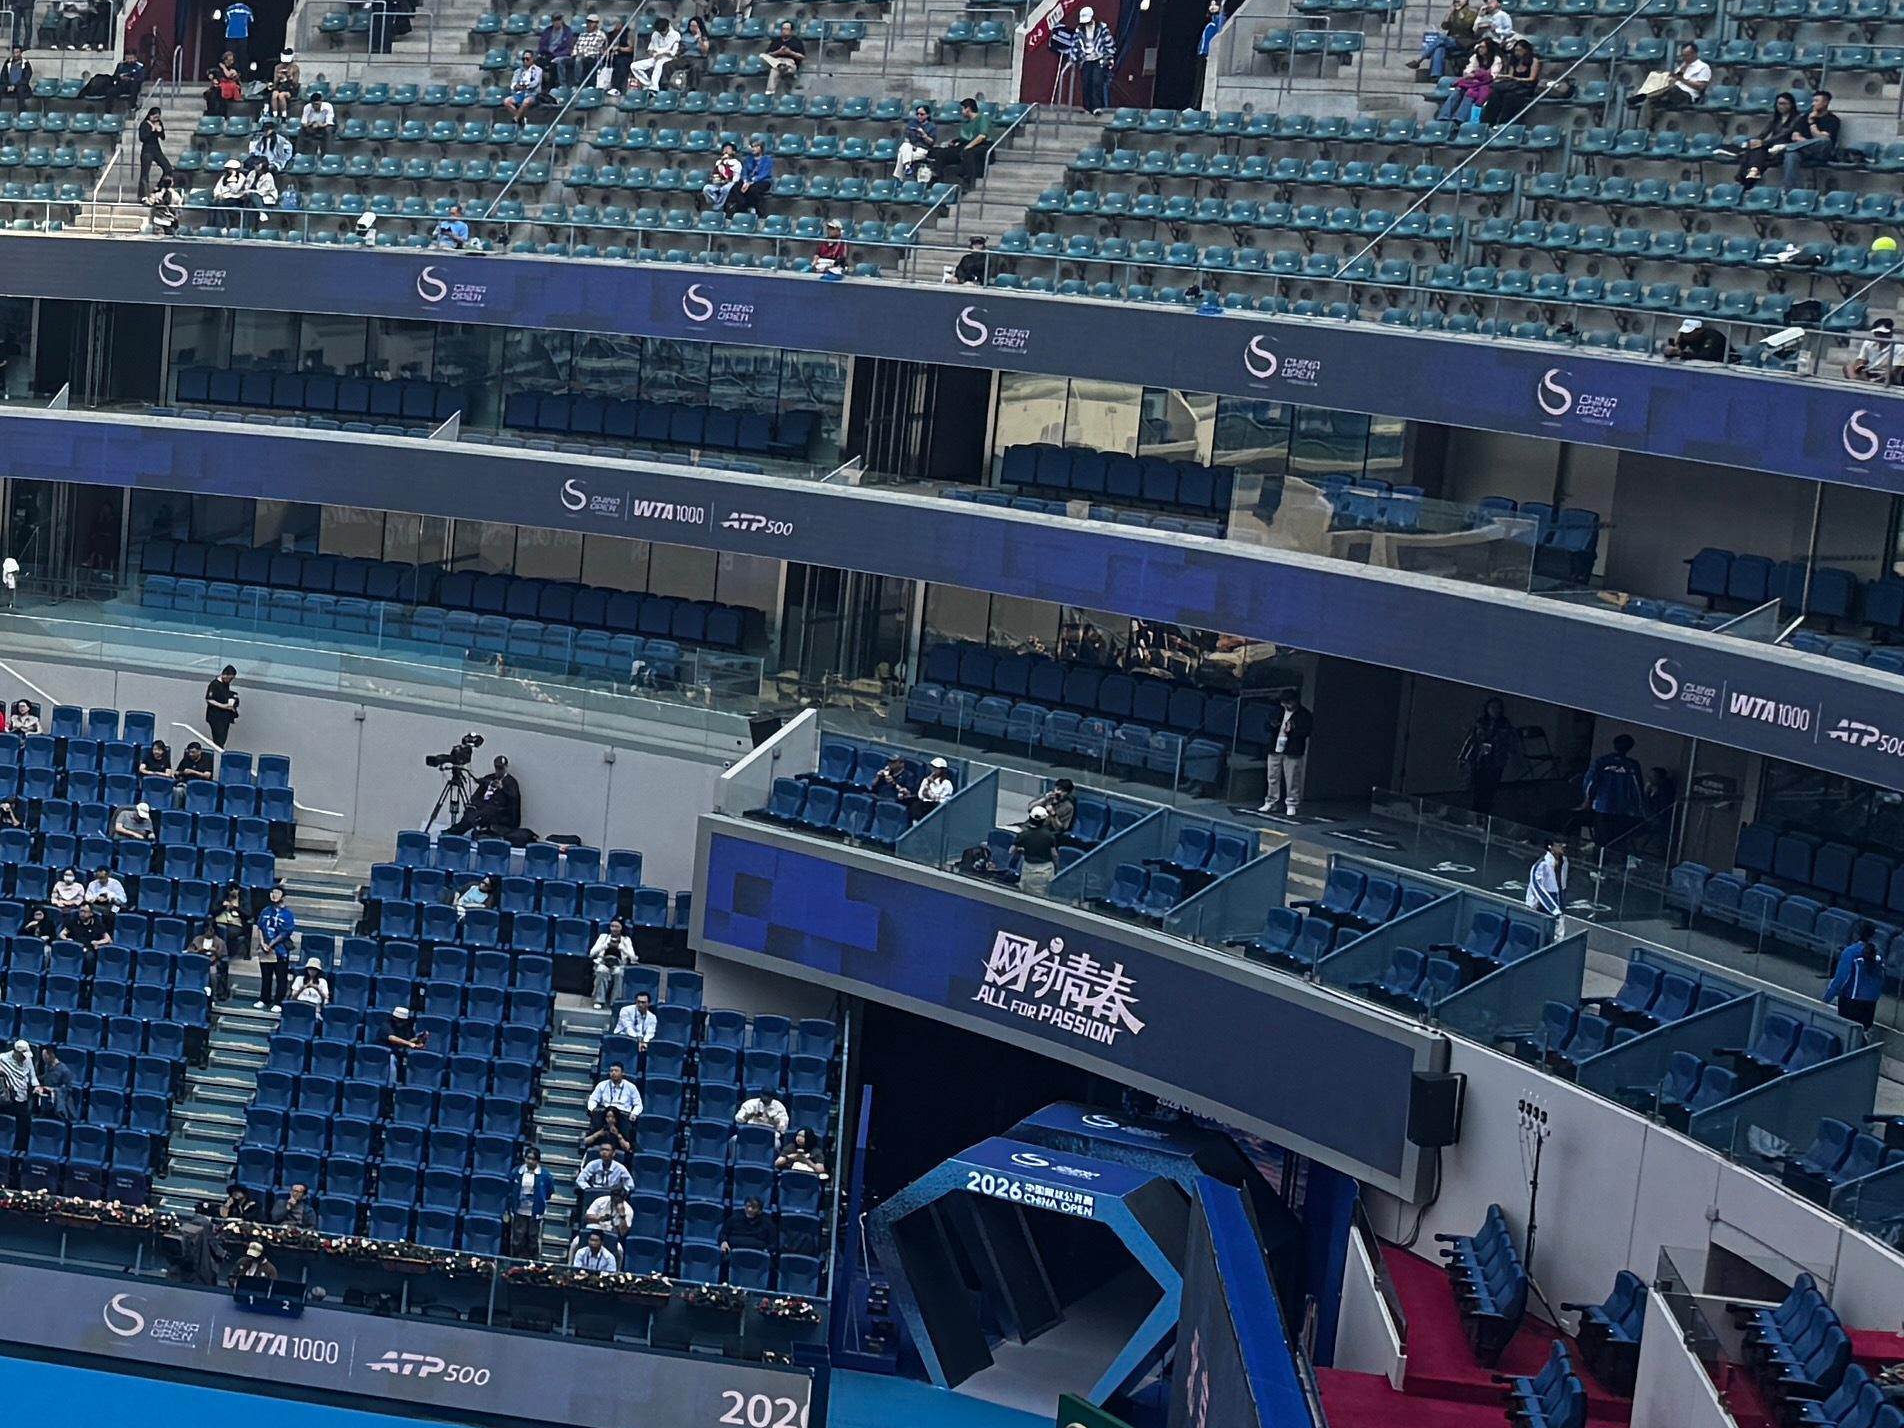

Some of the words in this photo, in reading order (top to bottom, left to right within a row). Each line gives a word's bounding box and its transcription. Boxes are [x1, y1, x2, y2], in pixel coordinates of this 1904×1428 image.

[633, 500, 674, 521] WTA
[676, 505, 705, 524] 1000
[719, 512, 768, 532] ATP
[765, 521, 794, 536] 500
[1730, 692, 1776, 723] WTA
[1777, 703, 1810, 732] 1000
[1825, 719, 1881, 747] ATP
[981, 930, 1146, 1035] 网动青春
[971, 984, 1009, 1010] ALL
[1010, 1000, 1037, 1020] FOR
[1037, 1004, 1124, 1046] PASSION
[966, 1170, 1023, 1200] 2026
[1023, 1193, 1058, 1211] CHINA
[1060, 1201, 1093, 1217] OPEN
[150, 1326, 194, 1342] OPEN
[153, 1318, 199, 1332] CHINA
[222, 1326, 289, 1356] WTA
[291, 1336, 340, 1364] 1000
[365, 1350, 446, 1378] ATP
[444, 1359, 491, 1386] 500
